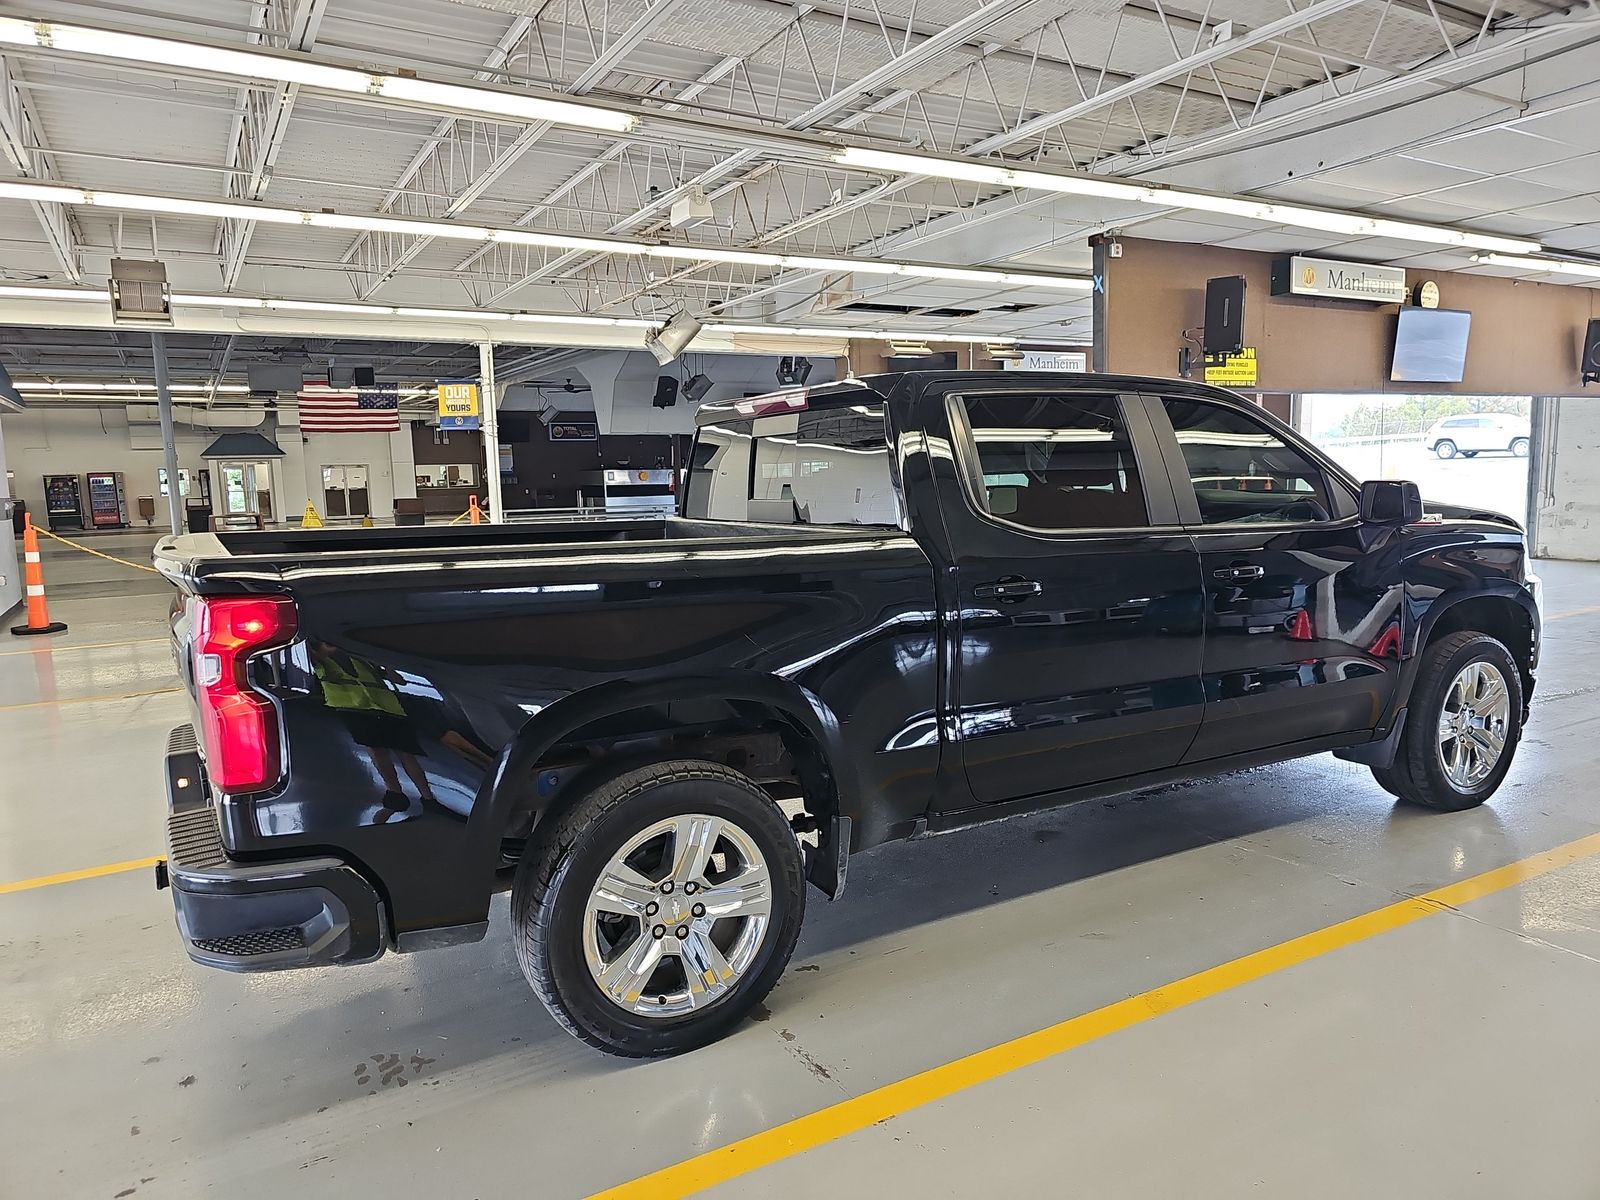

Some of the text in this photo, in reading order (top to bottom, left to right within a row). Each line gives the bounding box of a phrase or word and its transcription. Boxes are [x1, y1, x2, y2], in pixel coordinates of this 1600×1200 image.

[1327, 269, 1397, 295] Manheim
[1029, 357, 1079, 369] Manheim
[445, 386, 470, 399] OUR
[446, 404, 471, 412] YOURS
